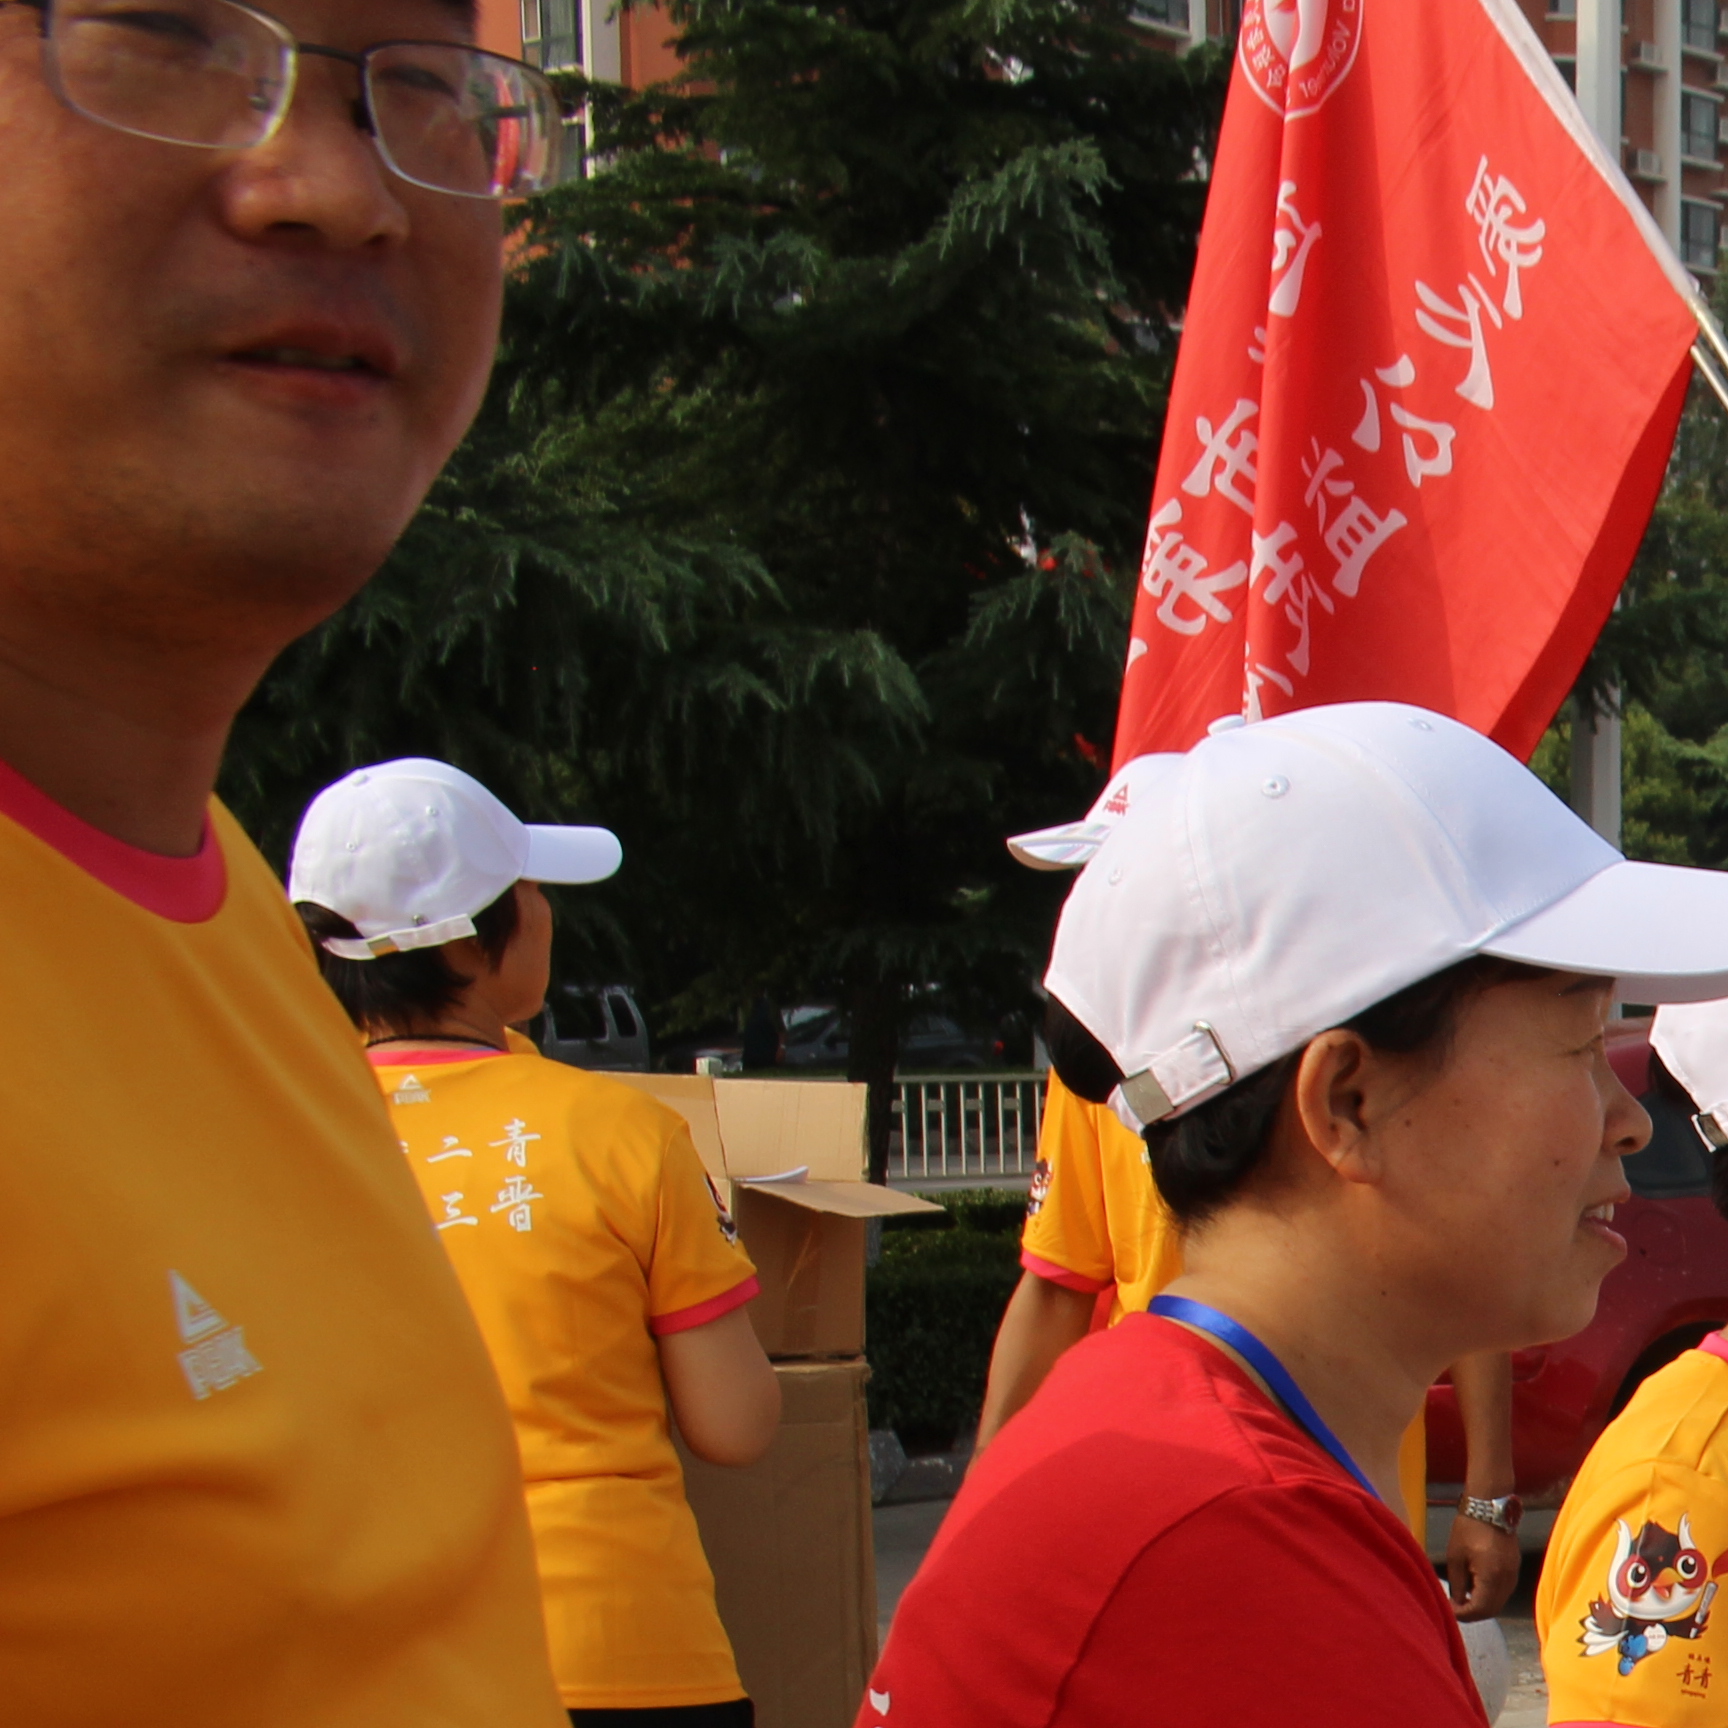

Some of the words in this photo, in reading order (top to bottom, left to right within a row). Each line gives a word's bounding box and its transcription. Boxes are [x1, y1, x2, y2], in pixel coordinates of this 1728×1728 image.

[399, 1118, 542, 1168] 二青
[434, 1174, 545, 1232] 三晋
[1676, 1662, 1713, 1690] 青青
